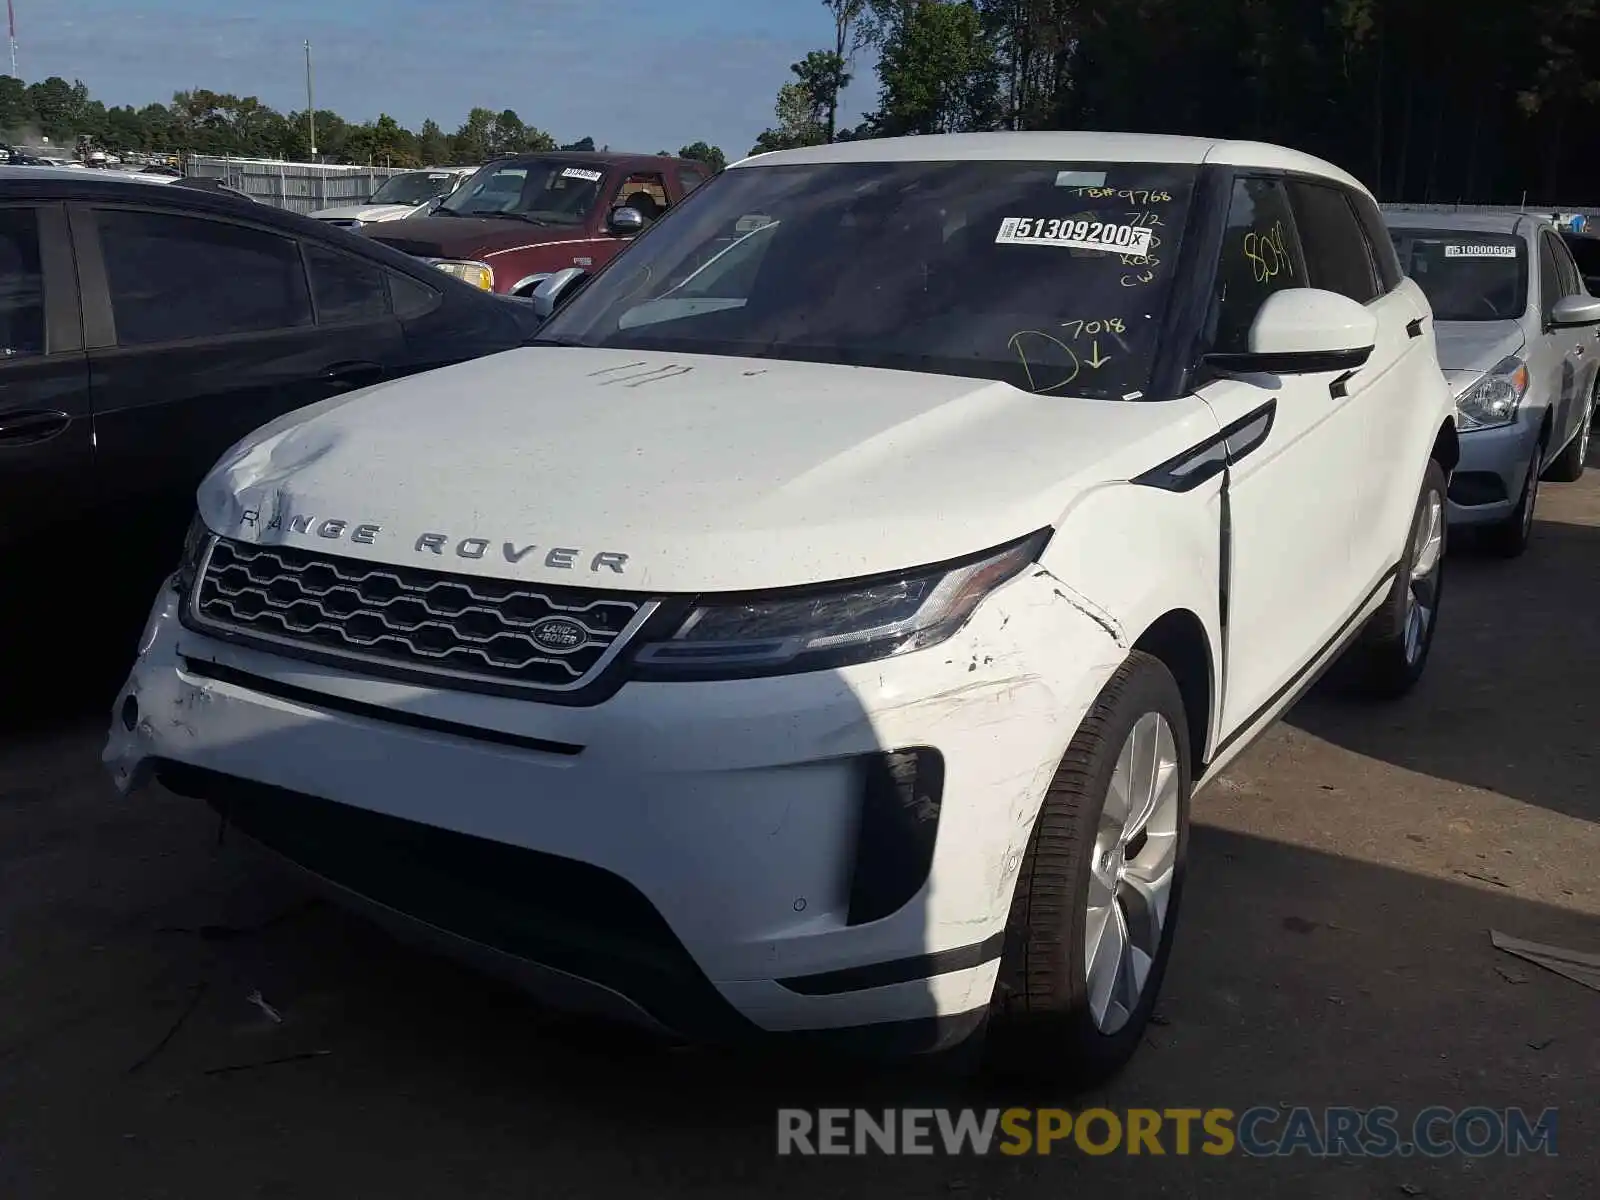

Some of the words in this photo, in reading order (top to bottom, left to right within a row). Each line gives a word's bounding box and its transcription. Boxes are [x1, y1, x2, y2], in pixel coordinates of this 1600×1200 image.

[239, 510, 382, 544] RANGE
[414, 533, 630, 574] ROVER
[542, 624, 571, 634] LAND
[542, 633, 577, 645] ROVER
